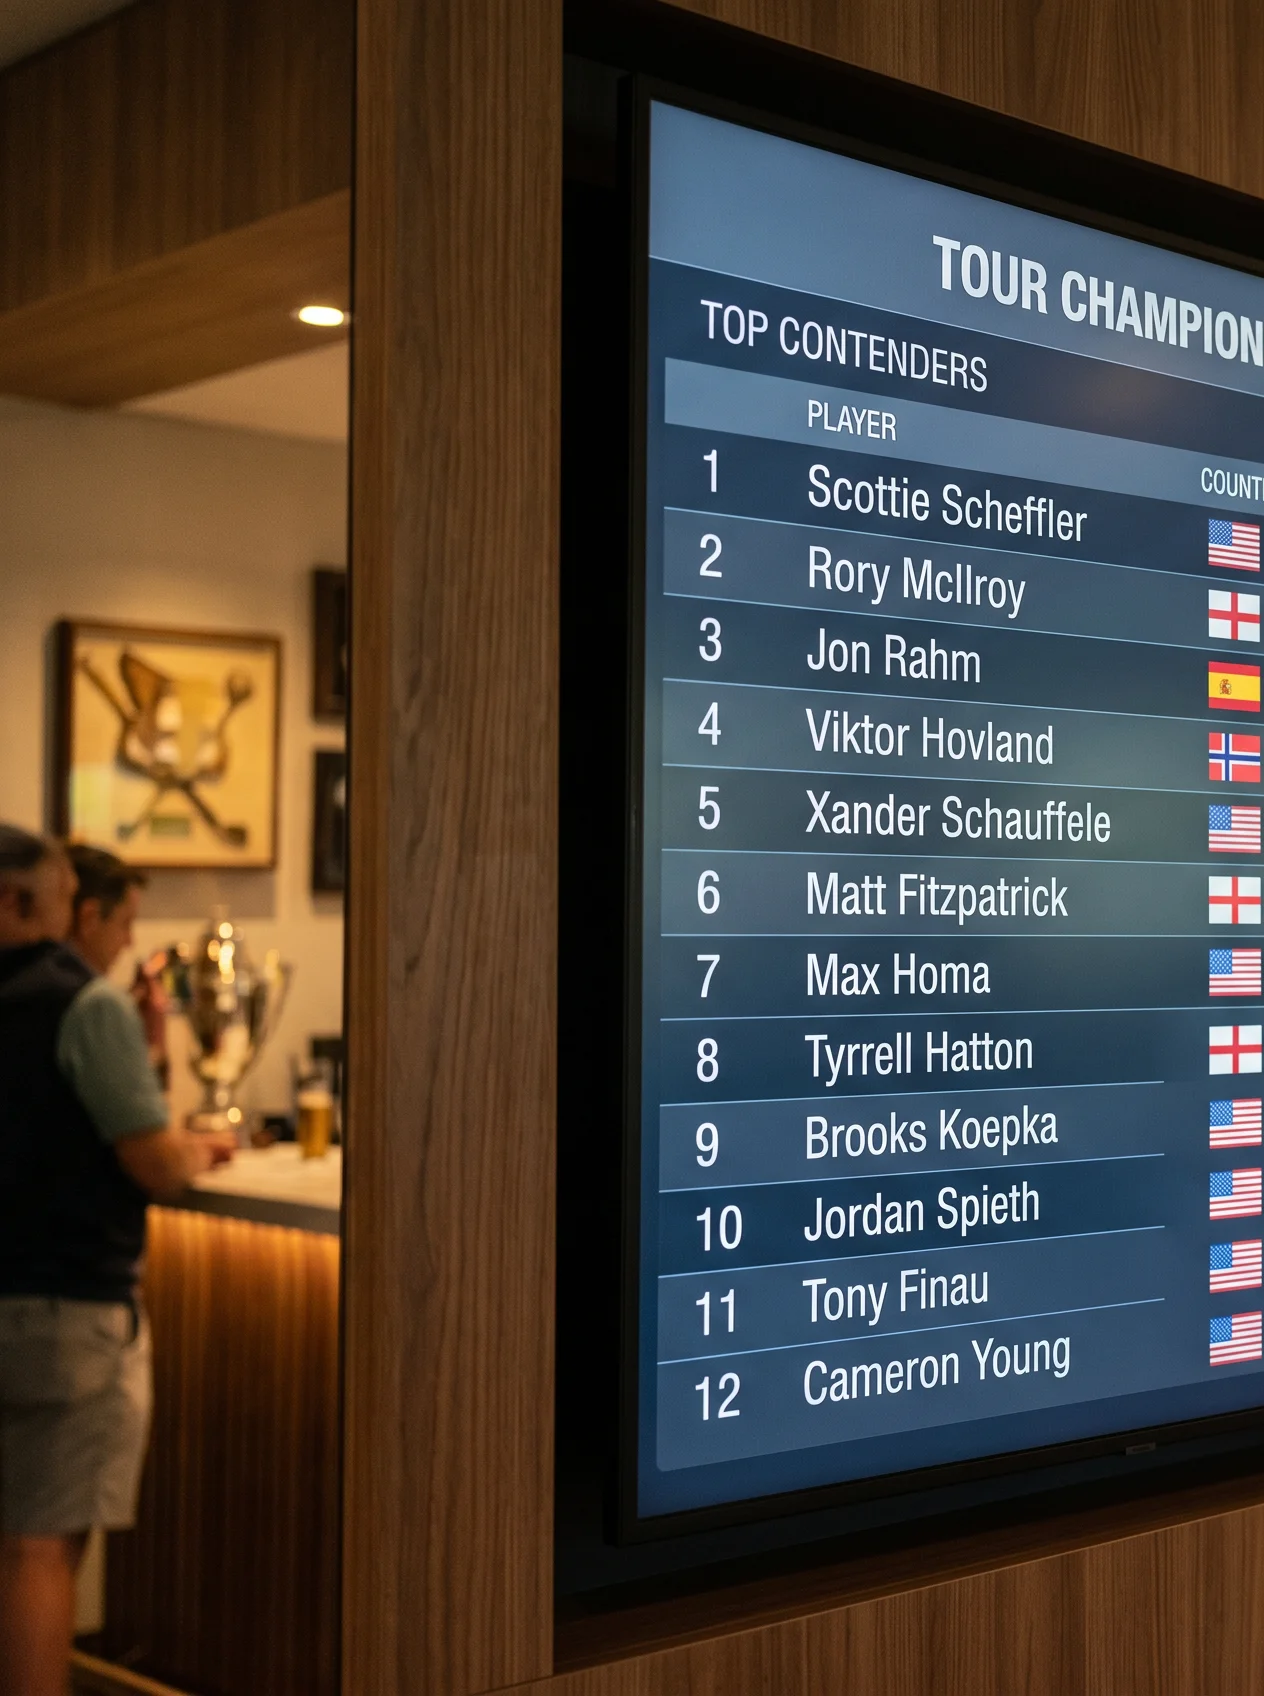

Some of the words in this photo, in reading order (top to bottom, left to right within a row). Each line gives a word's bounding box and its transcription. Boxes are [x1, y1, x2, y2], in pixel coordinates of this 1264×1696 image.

[932, 234, 1048, 315] TOUR
[700, 299, 769, 347] TOP
[779, 317, 989, 393] CONTENDERS
[808, 399, 897, 441] PLAYER
[703, 449, 718, 493] 1
[807, 463, 930, 523] Scottie
[941, 483, 1088, 544] Scheffler
[699, 533, 723, 578] 2
[809, 545, 891, 605] Rory
[903, 556, 1026, 619] McIlroy
[698, 617, 722, 662] 3
[806, 627, 870, 674] Jon
[885, 633, 981, 683] Rahm
[697, 701, 722, 746] 4
[805, 708, 910, 757] Viktor
[922, 716, 1053, 765] Hovland
[698, 785, 721, 830] 5
[805, 789, 931, 837] Xander
[941, 795, 1111, 843] Schauffele
[697, 869, 721, 915] 6
[807, 871, 887, 916] Matt
[899, 873, 1069, 926] Fitzpatrick
[696, 954, 721, 998] 7
[807, 953, 881, 996] Max
[893, 952, 991, 995] Homa
[696, 1037, 719, 1083] 8
[804, 1031, 912, 1087] Tyrrell
[926, 1030, 1033, 1073] Hatton
[695, 1122, 719, 1168] 9
[806, 1111, 927, 1160] Brooks
[939, 1104, 1059, 1156] Koepka
[696, 1204, 743, 1252] 10
[804, 1192, 924, 1242] Jordan
[937, 1181, 1041, 1235] Spieth
[695, 1288, 735, 1336] 11
[802, 1277, 888, 1327] Tony
[900, 1267, 989, 1312] Finau
[695, 1372, 741, 1421] 12
[803, 1352, 959, 1406] Cameron
[971, 1336, 1070, 1381] Young
